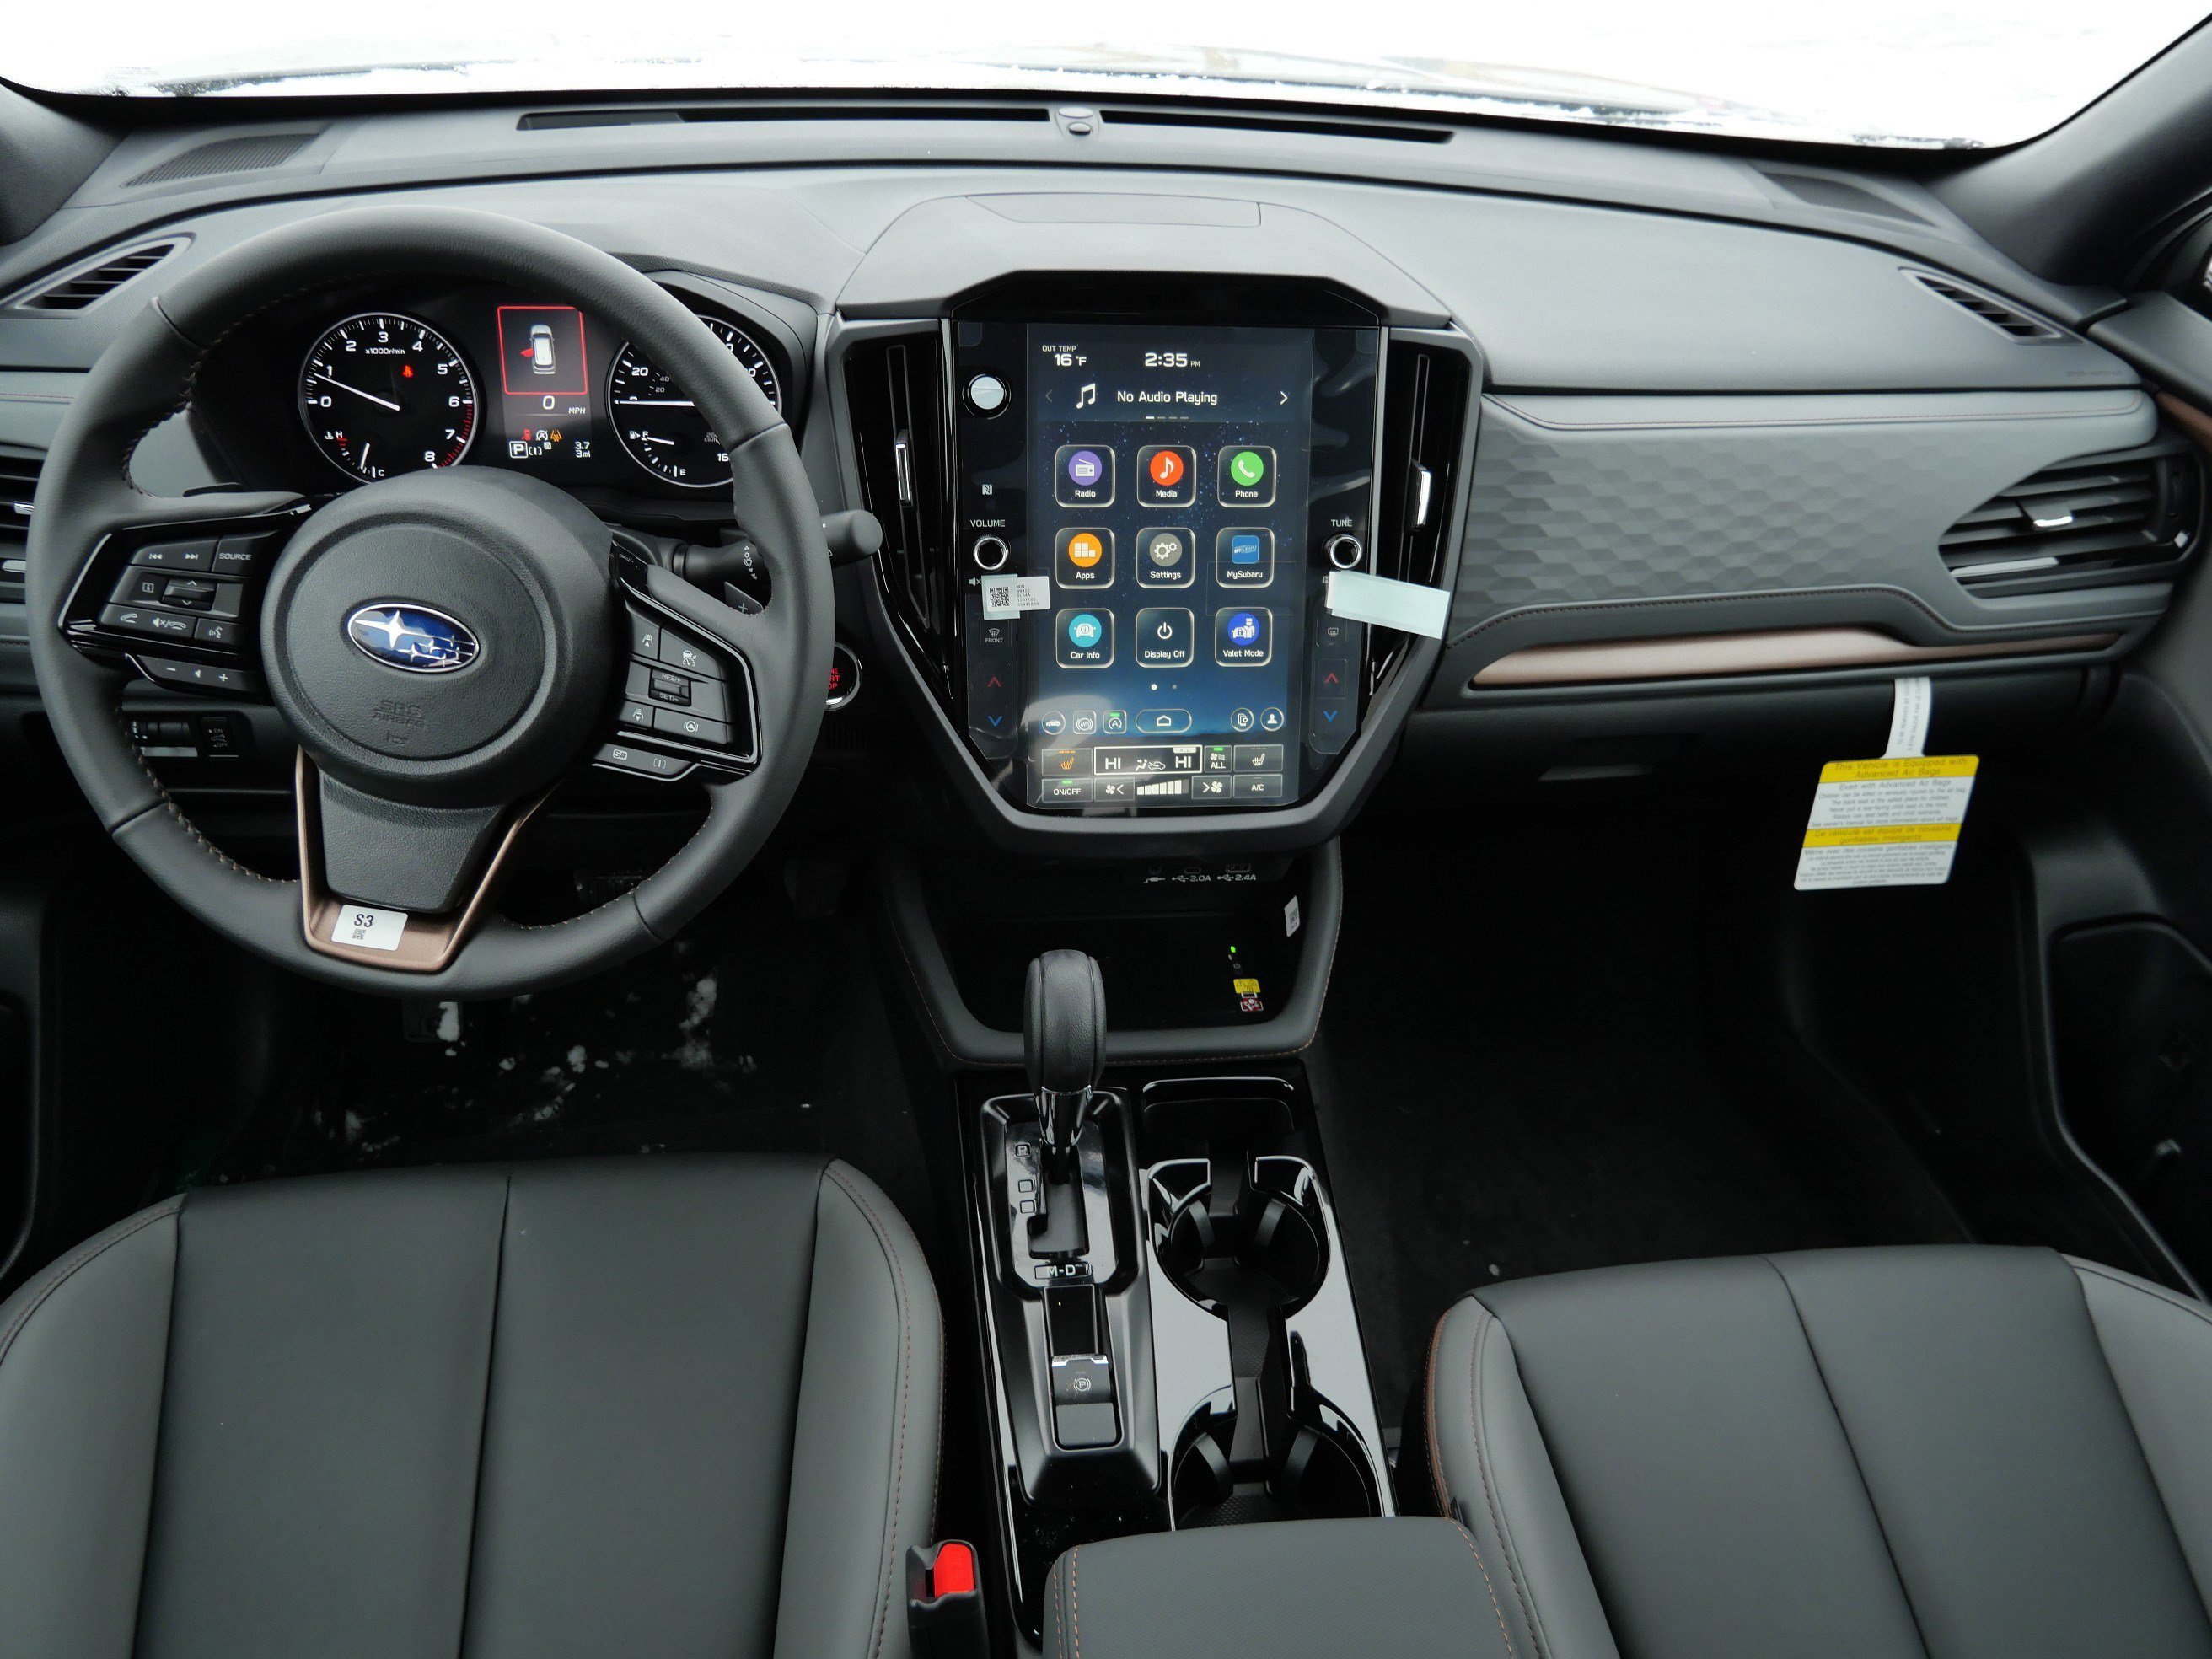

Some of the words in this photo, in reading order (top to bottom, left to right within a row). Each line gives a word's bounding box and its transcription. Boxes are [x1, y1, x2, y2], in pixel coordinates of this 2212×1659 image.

[378, 331, 389, 342] 3
[346, 340, 357, 352] 2
[412, 341, 423, 352] 4
[1054, 353, 1072, 367] 16
[1145, 352, 1188, 368] 2:35
[325, 365, 333, 377] 1
[437, 363, 448, 374] 5
[632, 367, 648, 376] 20
[320, 395, 332, 407] 0
[448, 396, 459, 408] 6
[1117, 390, 1134, 403] No
[1138, 390, 1171, 403] Audio
[1175, 390, 1218, 405] Playing
[542, 395, 555, 410] 0
[445, 429, 455, 440] 7
[575, 442, 590, 450] 3.7
[424, 451, 435, 463] 8
[717, 453, 730, 462] 16
[379, 469, 385, 477] C
[1075, 490, 1096, 498] Radio
[1156, 490, 1178, 498] Media
[1235, 490, 1259, 498] Phone
[969, 519, 1006, 528] VOLUME
[1330, 519, 1353, 528] TUNE
[219, 552, 252, 561] SOURCE
[1076, 571, 1095, 580] Apps
[1150, 571, 1182, 580] Settings
[1227, 571, 1263, 580] MySubaru
[1086, 651, 1100, 659] Info
[1144, 650, 1172, 659] Display
[1173, 650, 1185, 658] Off
[1222, 649, 1242, 658] Valet
[1243, 649, 1264, 658] Mode
[1105, 757, 1121, 770] HI
[1175, 756, 1191, 769] HI
[1211, 761, 1226, 770] ALL
[1834, 763, 1852, 771] This
[1857, 761, 1888, 770] Vehicle
[1903, 759, 1940, 769] Equipped
[1855, 770, 1898, 779] Advanced
[1918, 768, 1941, 777] Bags
[1251, 783, 1264, 792] A/C
[1932, 779, 1951, 787] Bags
[1053, 787, 1082, 796] ON/OFF
[354, 913, 374, 927] S3
